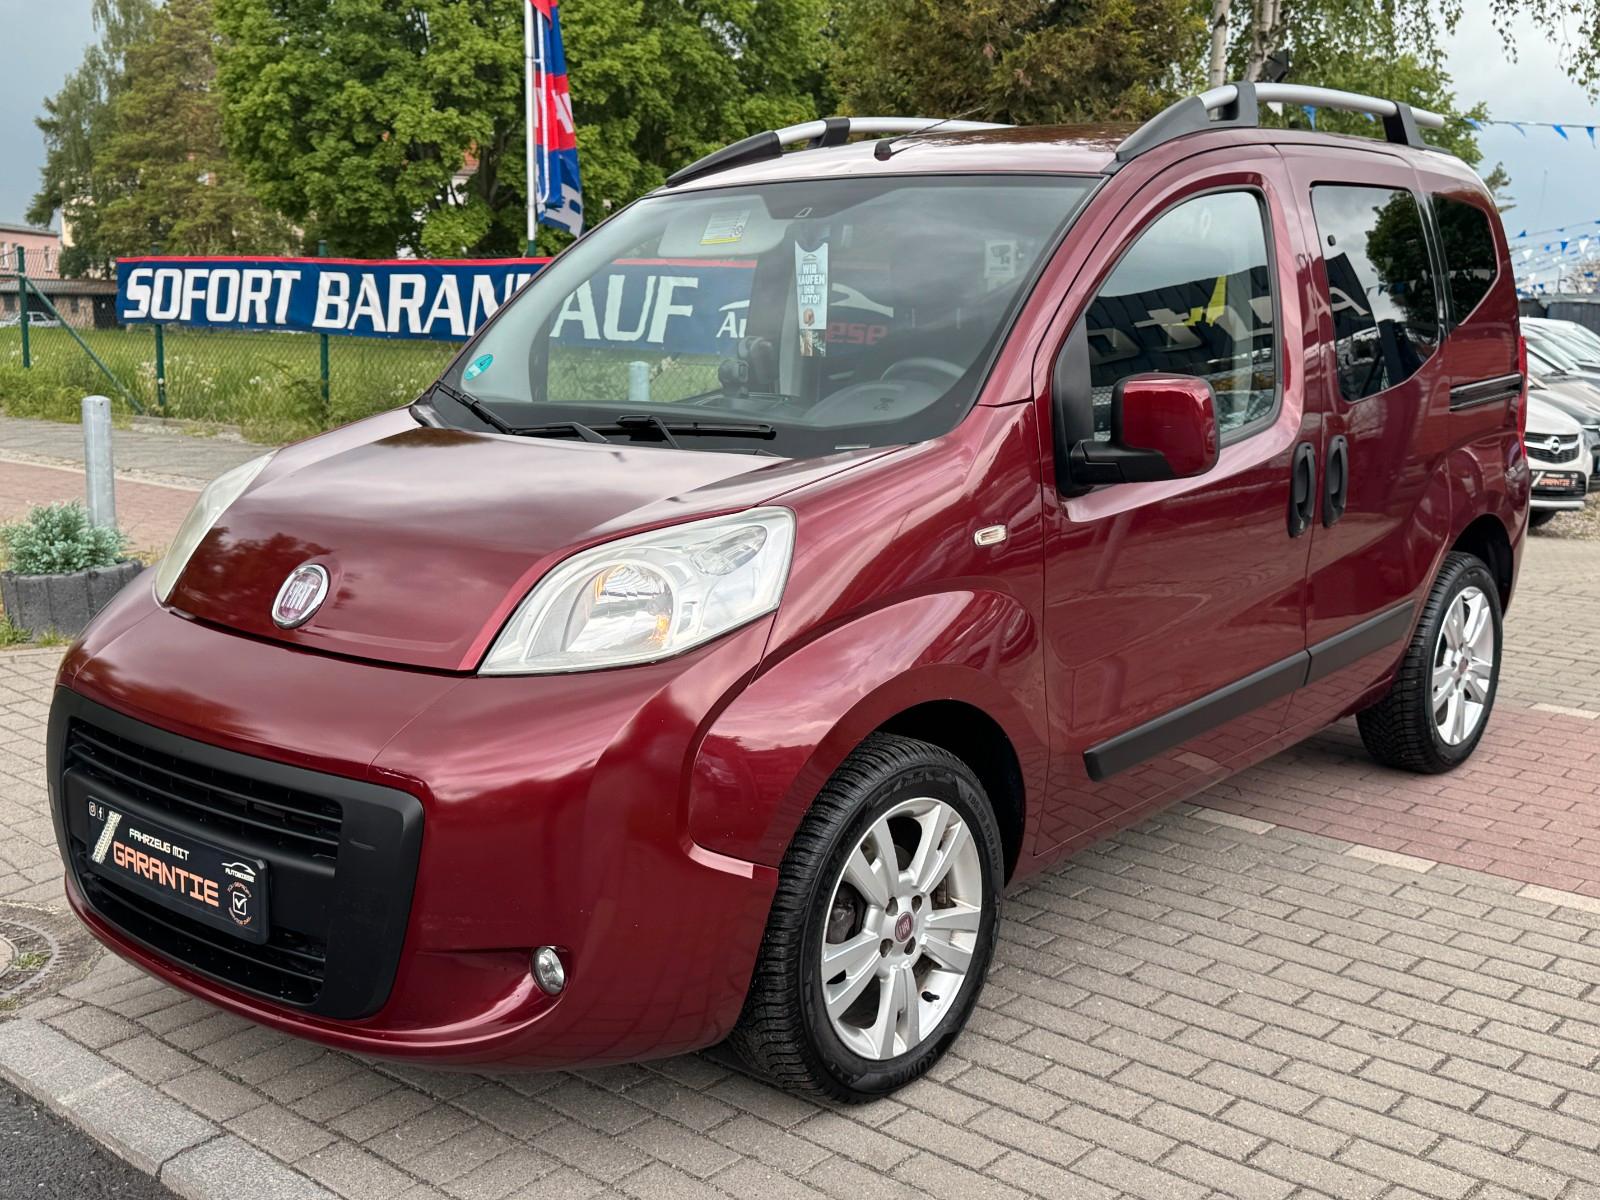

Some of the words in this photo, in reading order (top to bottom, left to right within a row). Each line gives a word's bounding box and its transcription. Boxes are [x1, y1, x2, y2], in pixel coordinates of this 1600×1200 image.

[123, 268, 301, 324] SOFORT
[281, 580, 317, 611] FIAT
[129, 827, 171, 854] FAHRZEUG
[172, 846, 190, 861] MIT
[113, 840, 219, 908] GARANTIE
